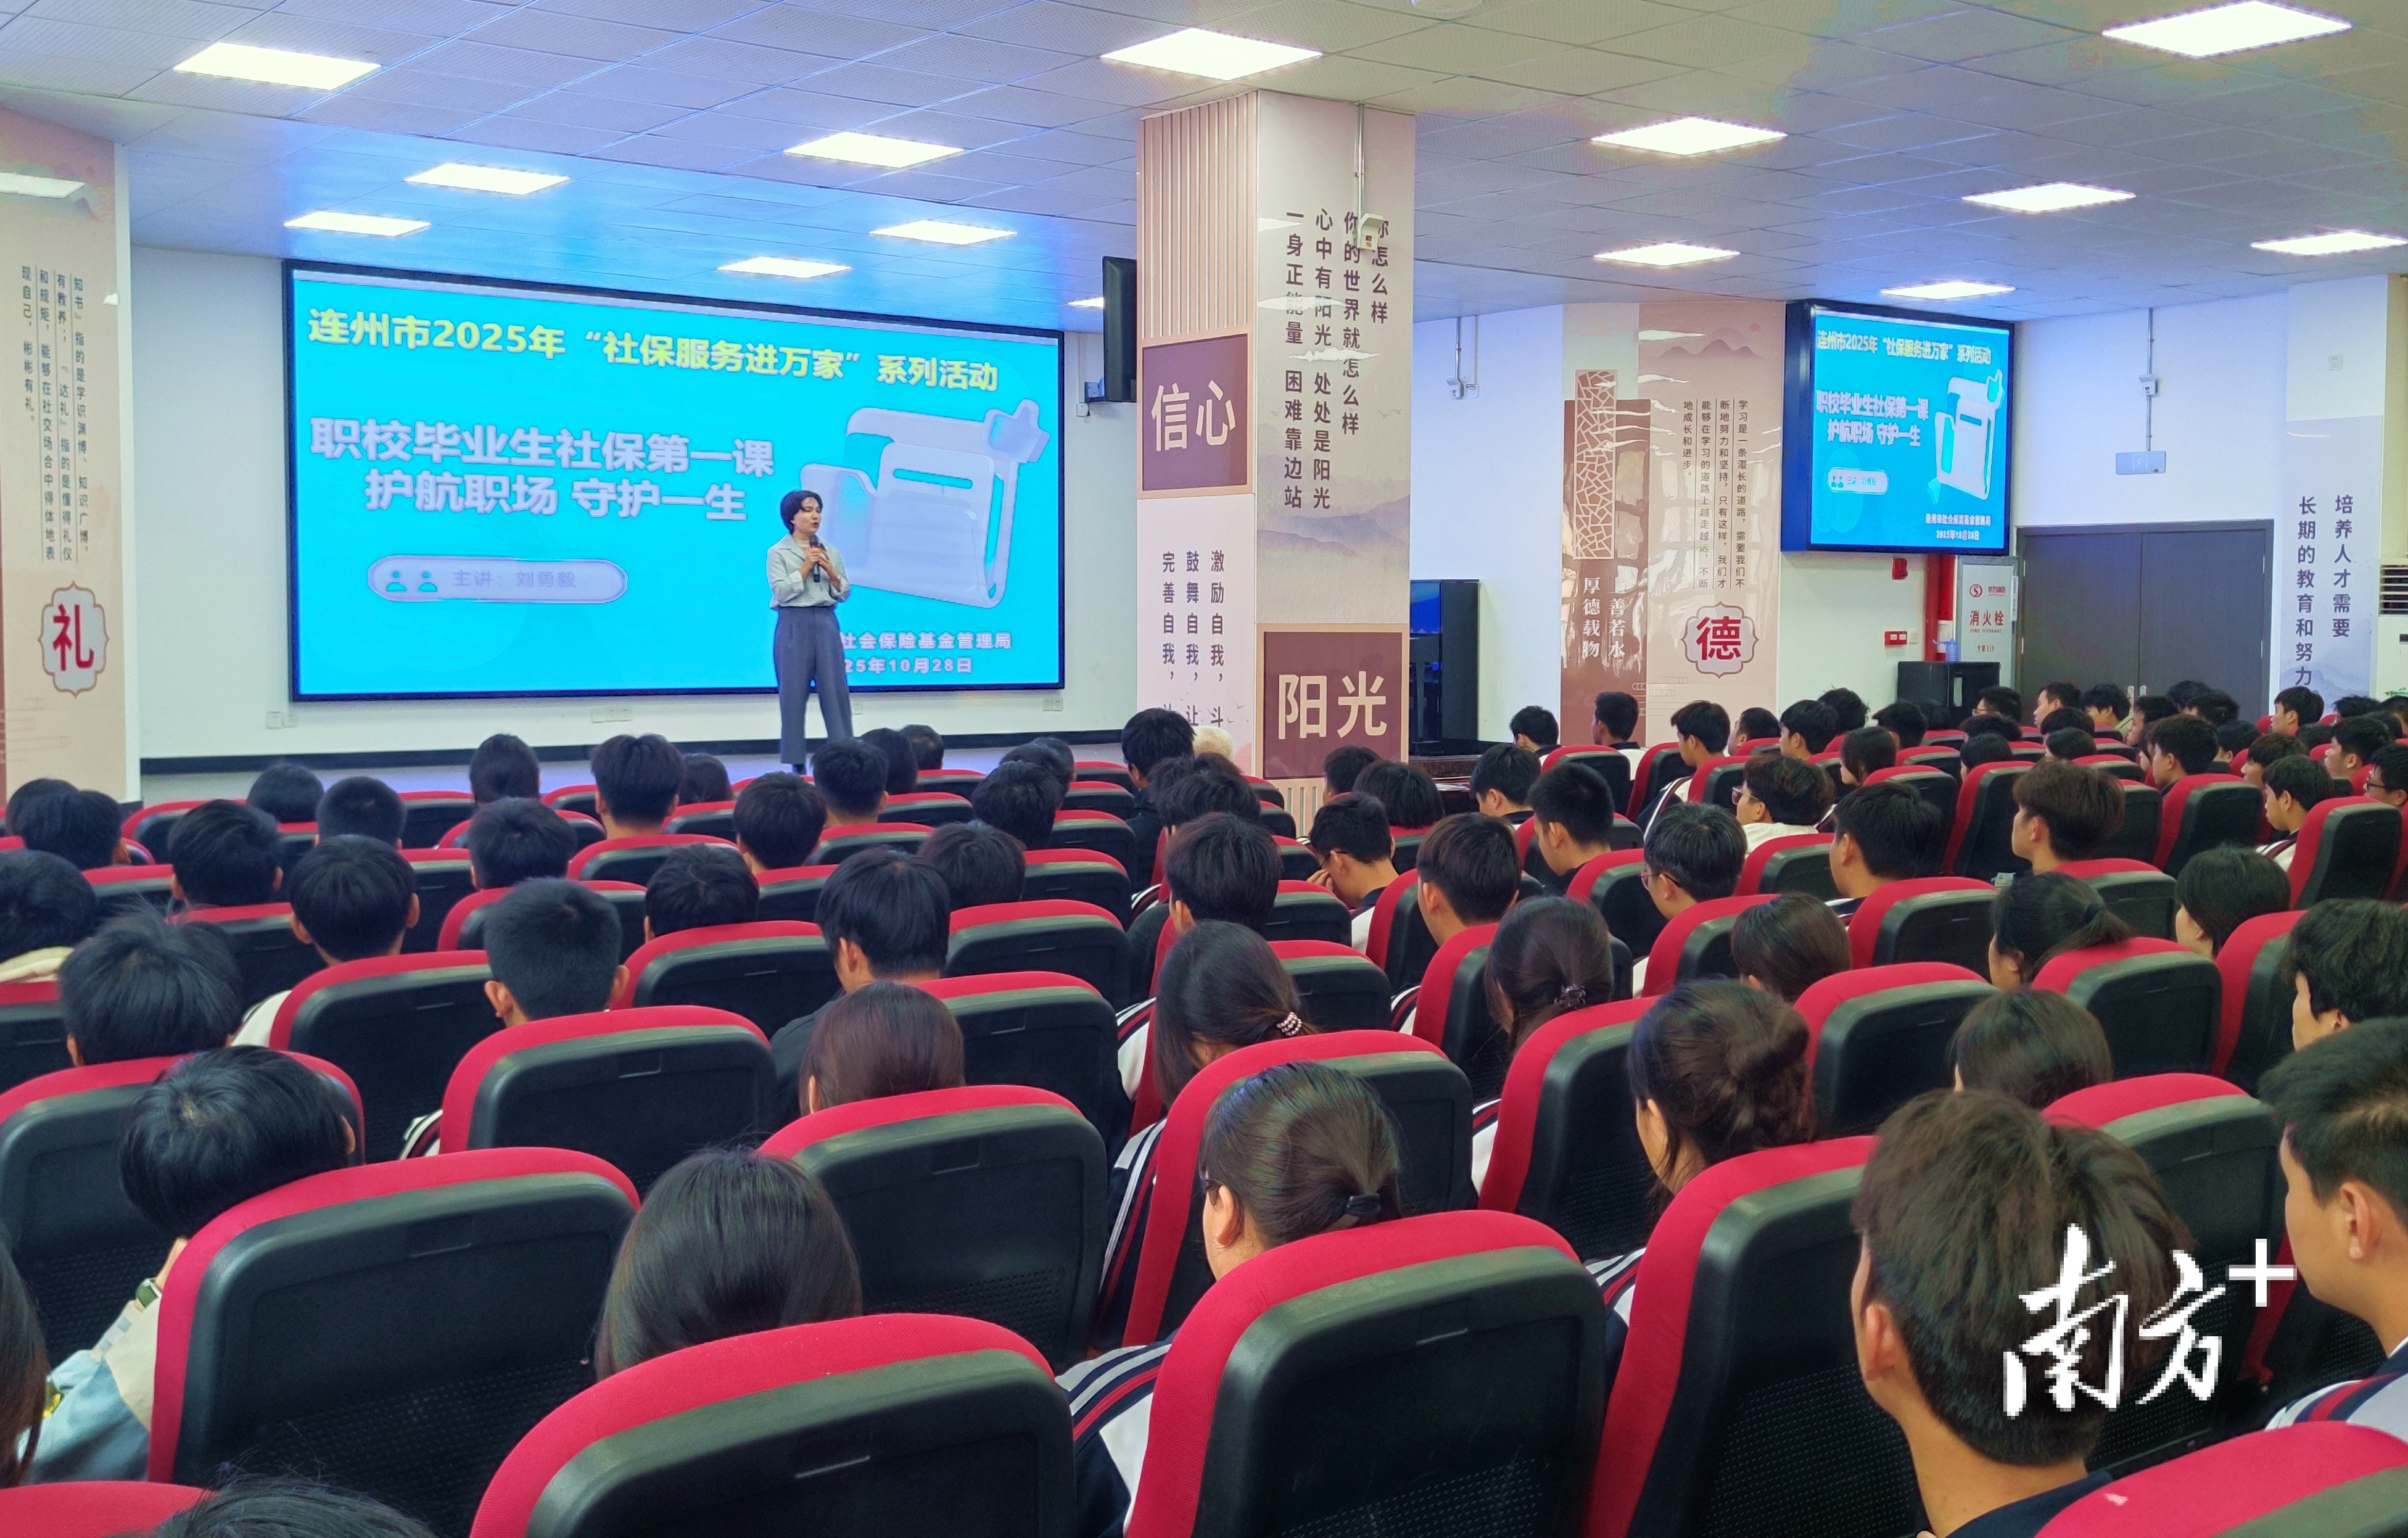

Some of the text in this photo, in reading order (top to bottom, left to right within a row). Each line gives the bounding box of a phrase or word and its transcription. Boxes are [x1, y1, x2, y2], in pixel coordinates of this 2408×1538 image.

[1313, 208, 1333, 510] 心中有阳光 处处是阳光
[1151, 379, 1236, 452] 信心
[1284, 370, 1303, 509] 困难靠边站
[1682, 400, 1693, 476] 地成长和进步。
[1816, 390, 1929, 421] 职校毕业生社保第一课
[1827, 418, 1921, 447] 护航职场 守护一生
[310, 417, 776, 479] 职校毕业生社保第一课
[365, 468, 748, 521] 护航职场 守护一生
[2295, 495, 2317, 686] 长期的教育和努力
[2332, 494, 2354, 637] 培养人才需要
[52, 603, 94, 671] 礼
[1162, 550, 1175, 711] 完善自我，
[1582, 576, 1601, 659] 厚德载物
[1608, 576, 1627, 658] 上善若水
[1696, 616, 1741, 661] 德
[1969, 610, 2004, 627] 消火栓
[1279, 671, 1387, 740] 阳光
